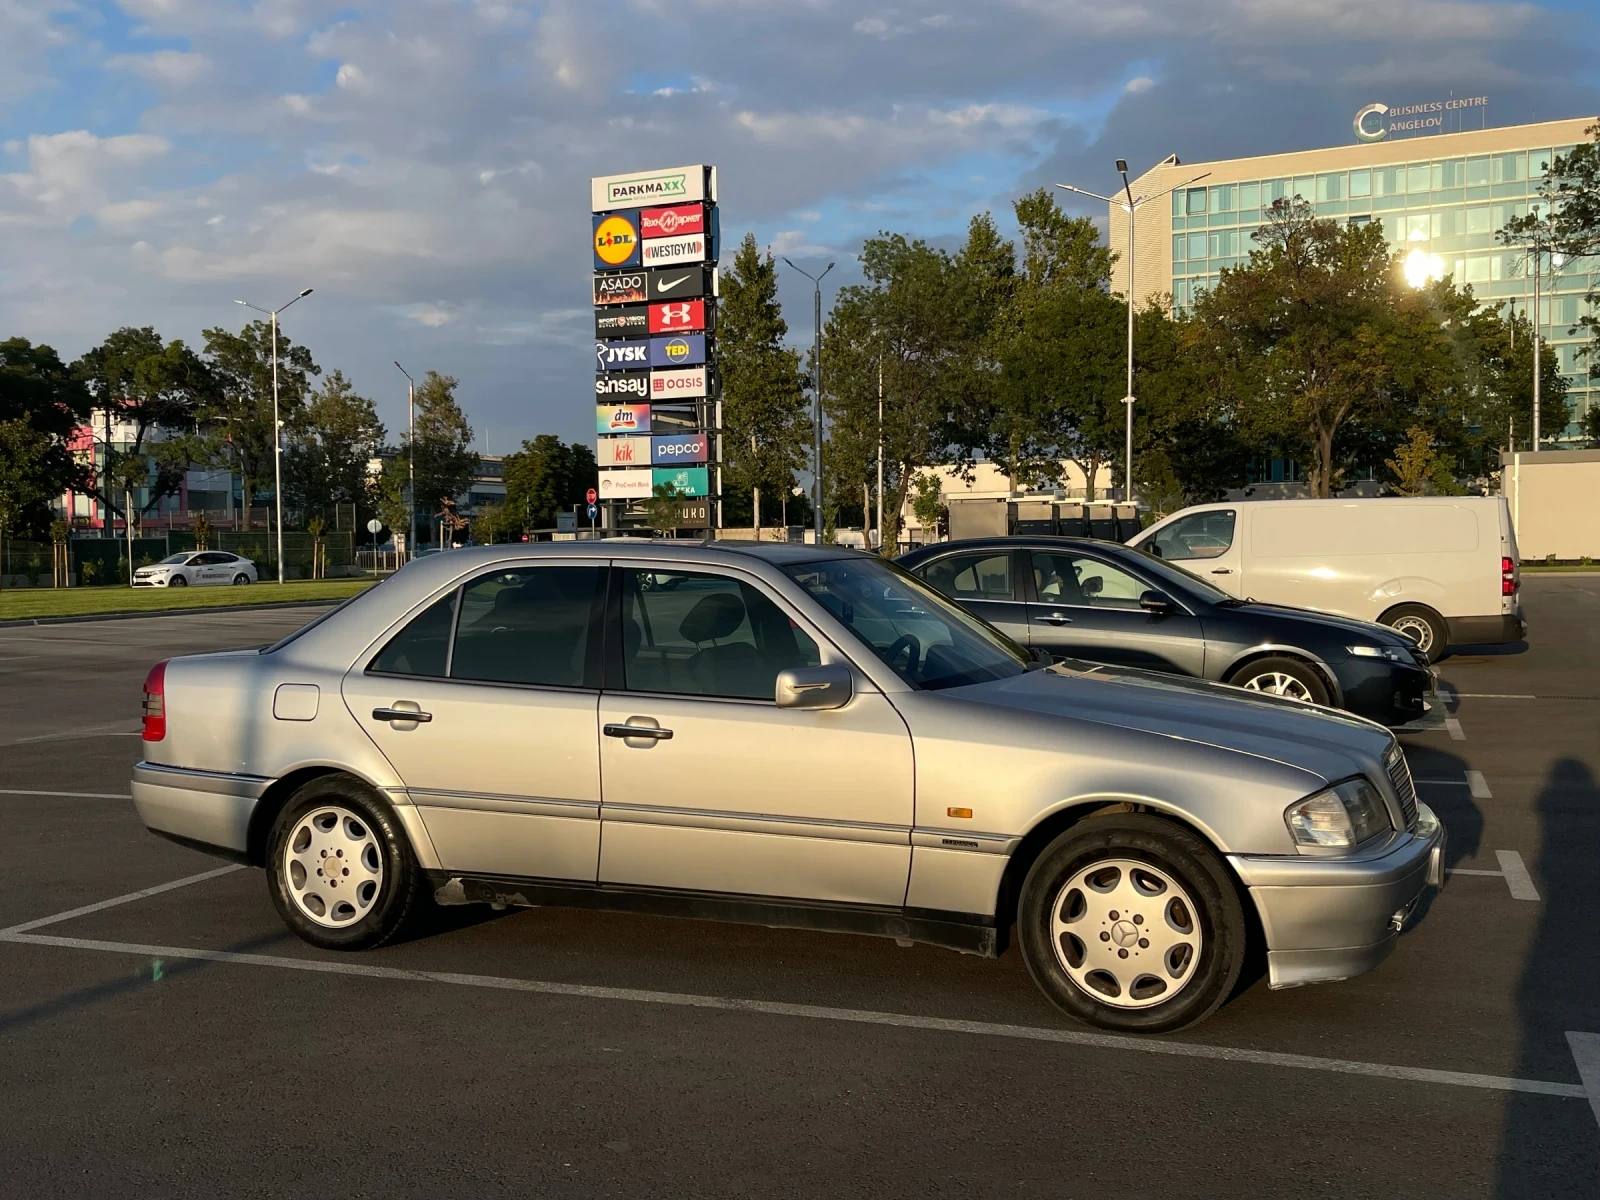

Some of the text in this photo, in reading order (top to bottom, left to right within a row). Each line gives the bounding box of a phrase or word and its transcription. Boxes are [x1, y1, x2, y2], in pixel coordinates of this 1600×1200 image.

[1389, 96, 1489, 117] BUSINESS CENTRE
[1389, 116, 1443, 132] ANGELOV
[613, 180, 680, 197] PARKMAXX
[651, 241, 696, 259] WESTGYM
[600, 276, 642, 291] ASADO
[607, 346, 647, 362] JYSK
[596, 376, 647, 397] sinsay
[667, 377, 703, 389] oasis
[614, 409, 633, 422] dm
[615, 443, 633, 462] kik
[658, 442, 700, 457] pepco
